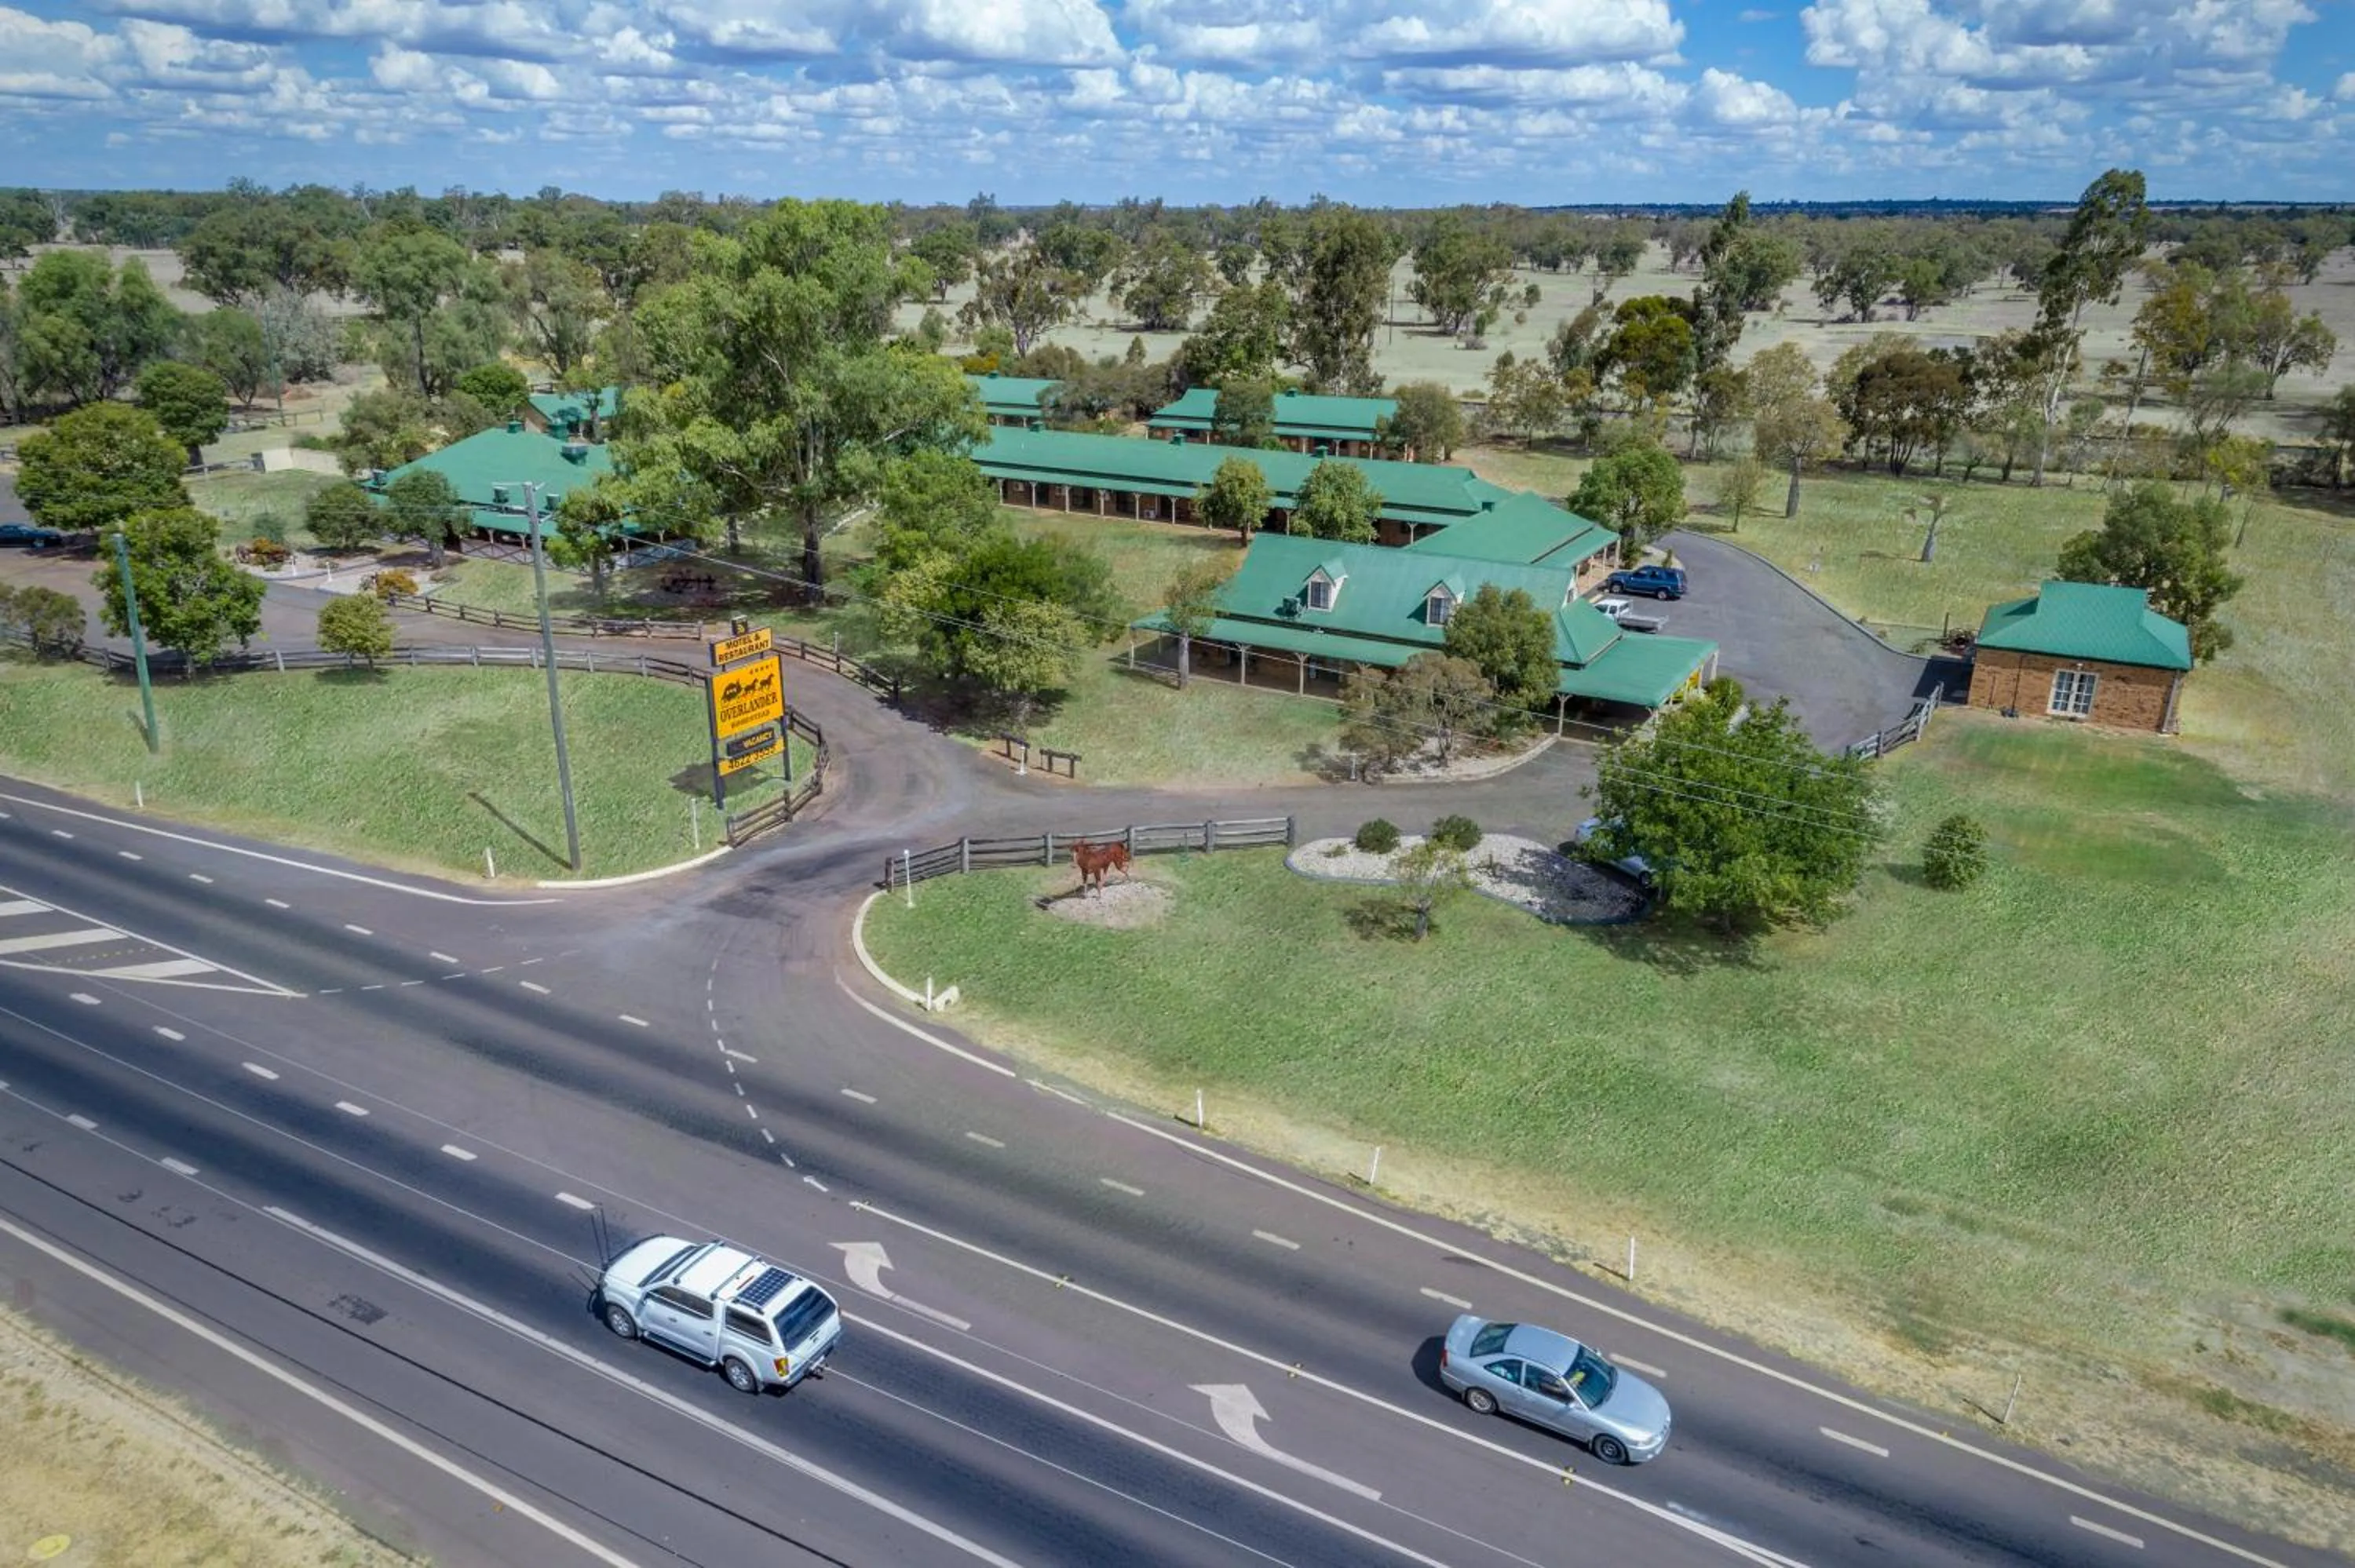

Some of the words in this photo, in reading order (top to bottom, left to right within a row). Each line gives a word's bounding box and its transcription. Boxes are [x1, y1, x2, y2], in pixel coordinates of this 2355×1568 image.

[718, 640, 769, 662] RESTAURANT
[725, 636, 752, 649] MOTEL
[754, 633, 761, 642] &
[720, 691, 778, 723] OVERLANDER
[743, 731, 773, 749] VACANCY
